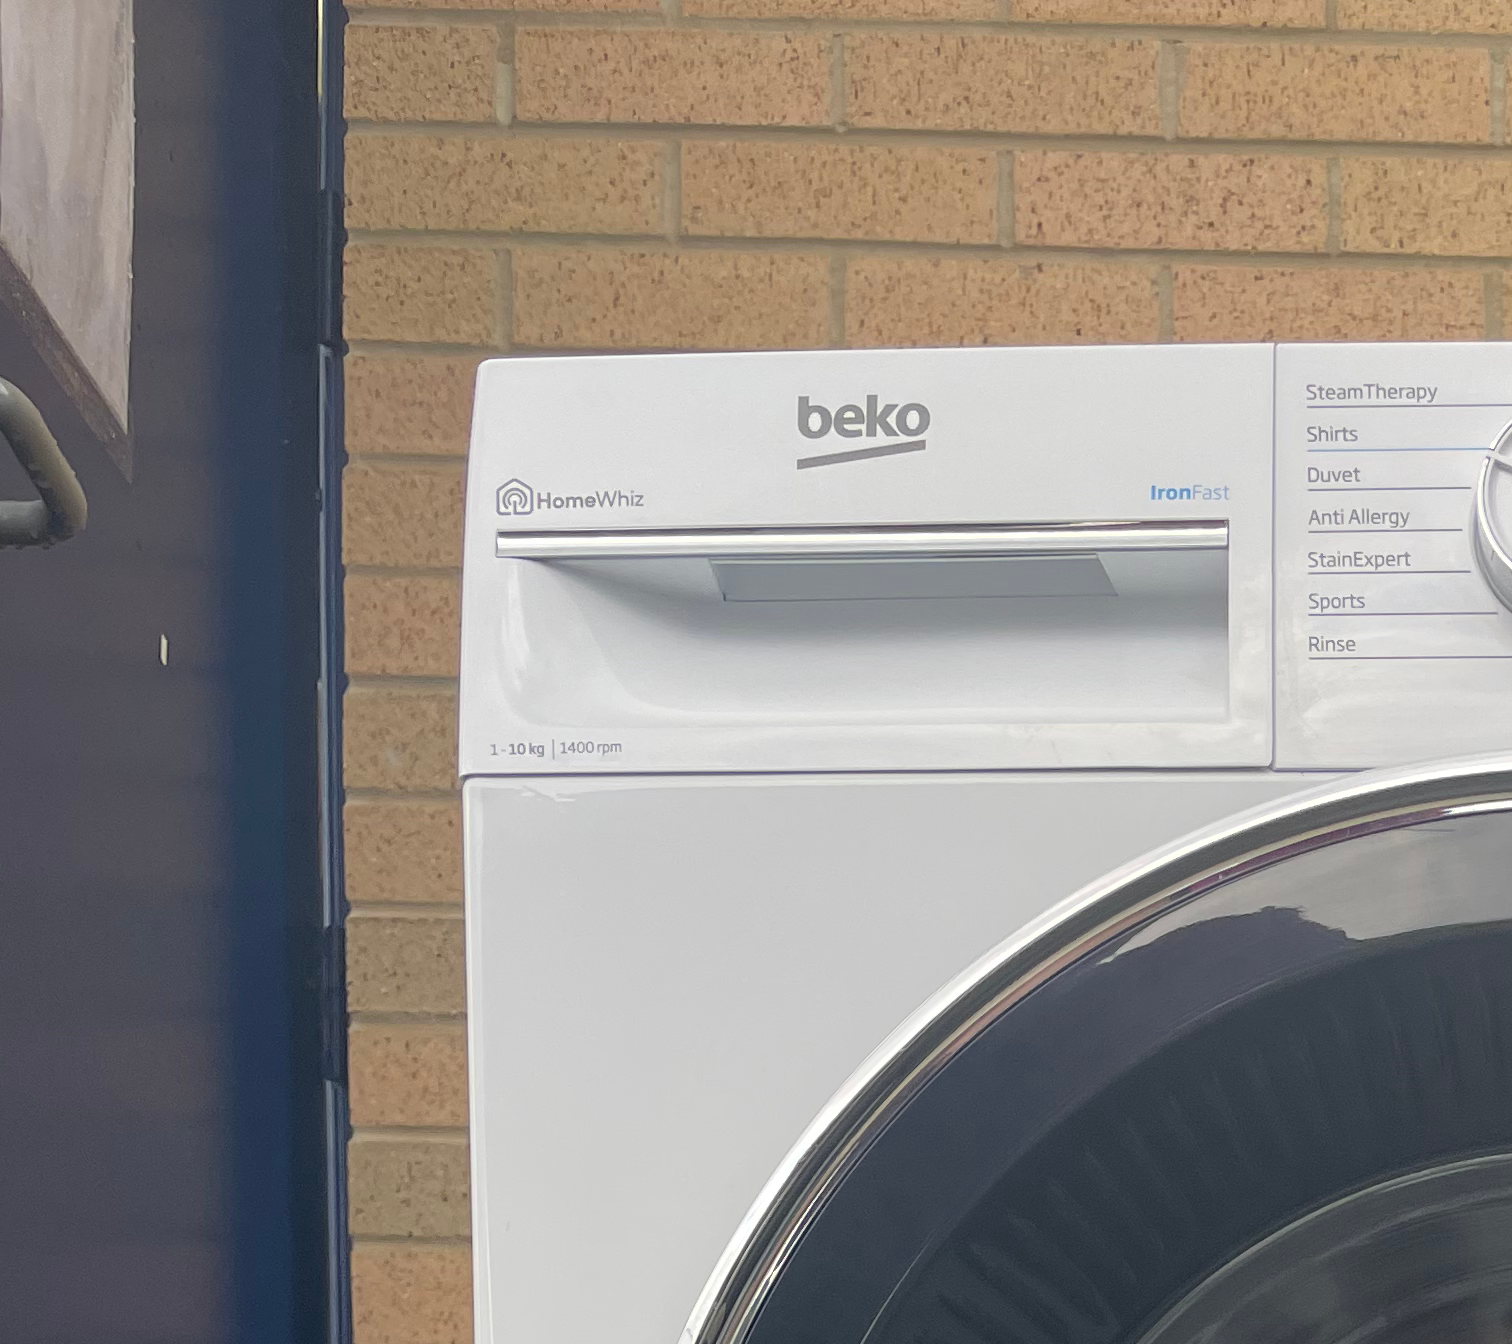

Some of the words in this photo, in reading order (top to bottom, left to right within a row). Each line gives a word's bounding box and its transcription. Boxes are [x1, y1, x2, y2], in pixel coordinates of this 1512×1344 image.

[1306, 383, 1437, 403] SteamTherapy
[797, 395, 931, 439] beko
[1307, 426, 1358, 442] Shirts
[1308, 467, 1360, 482] Duvet
[536, 490, 644, 511] HomeWhiz
[1151, 485, 1229, 500] IronFast
[1308, 509, 1344, 525] Anti
[1348, 508, 1410, 528] Allergy
[1308, 551, 1411, 570] StainExpert
[1309, 593, 1366, 612] Sports
[1309, 636, 1356, 652] Rinse
[529, 743, 544, 757] kg
[560, 741, 594, 754] 1400
[597, 743, 622, 756] rpm
